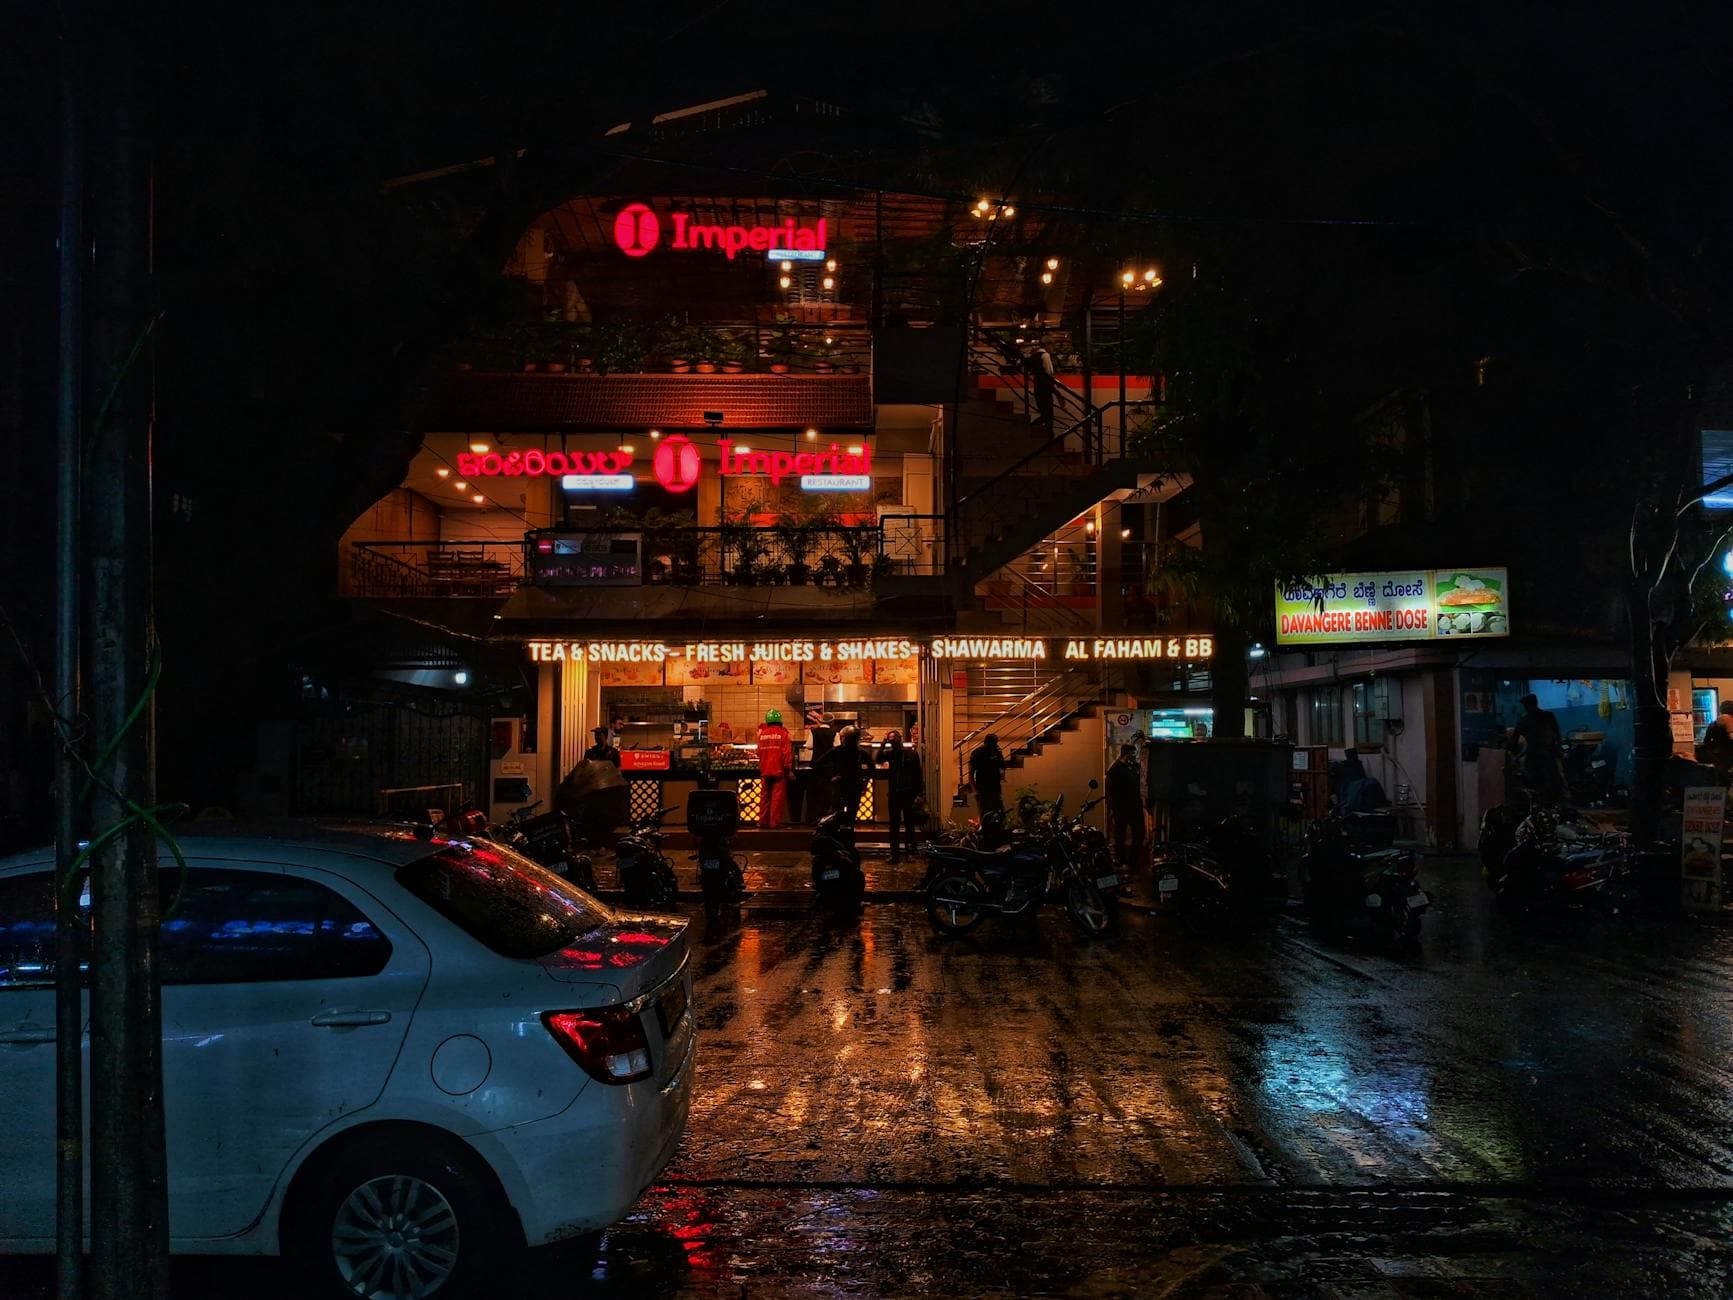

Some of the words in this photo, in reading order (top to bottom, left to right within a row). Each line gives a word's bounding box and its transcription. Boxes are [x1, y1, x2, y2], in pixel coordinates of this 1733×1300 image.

[672, 213, 826, 260] Imperial
[717, 439, 871, 486] Imperial
[807, 478, 864, 487] RESTAURANT
[1280, 611, 1351, 634] DAVANGERE
[1354, 610, 1393, 631] BENNE
[1395, 608, 1428, 630] DOSE
[528, 643, 566, 661] TEA
[572, 643, 584, 661] &
[686, 643, 744, 662] FRESH
[749, 643, 813, 661] JUICES
[819, 643, 832, 661] &
[931, 638, 1046, 659] SHAWARMA
[1065, 641, 1089, 659] AL
[1094, 639, 1162, 659] FAHAM
[1167, 640, 1181, 658] &
